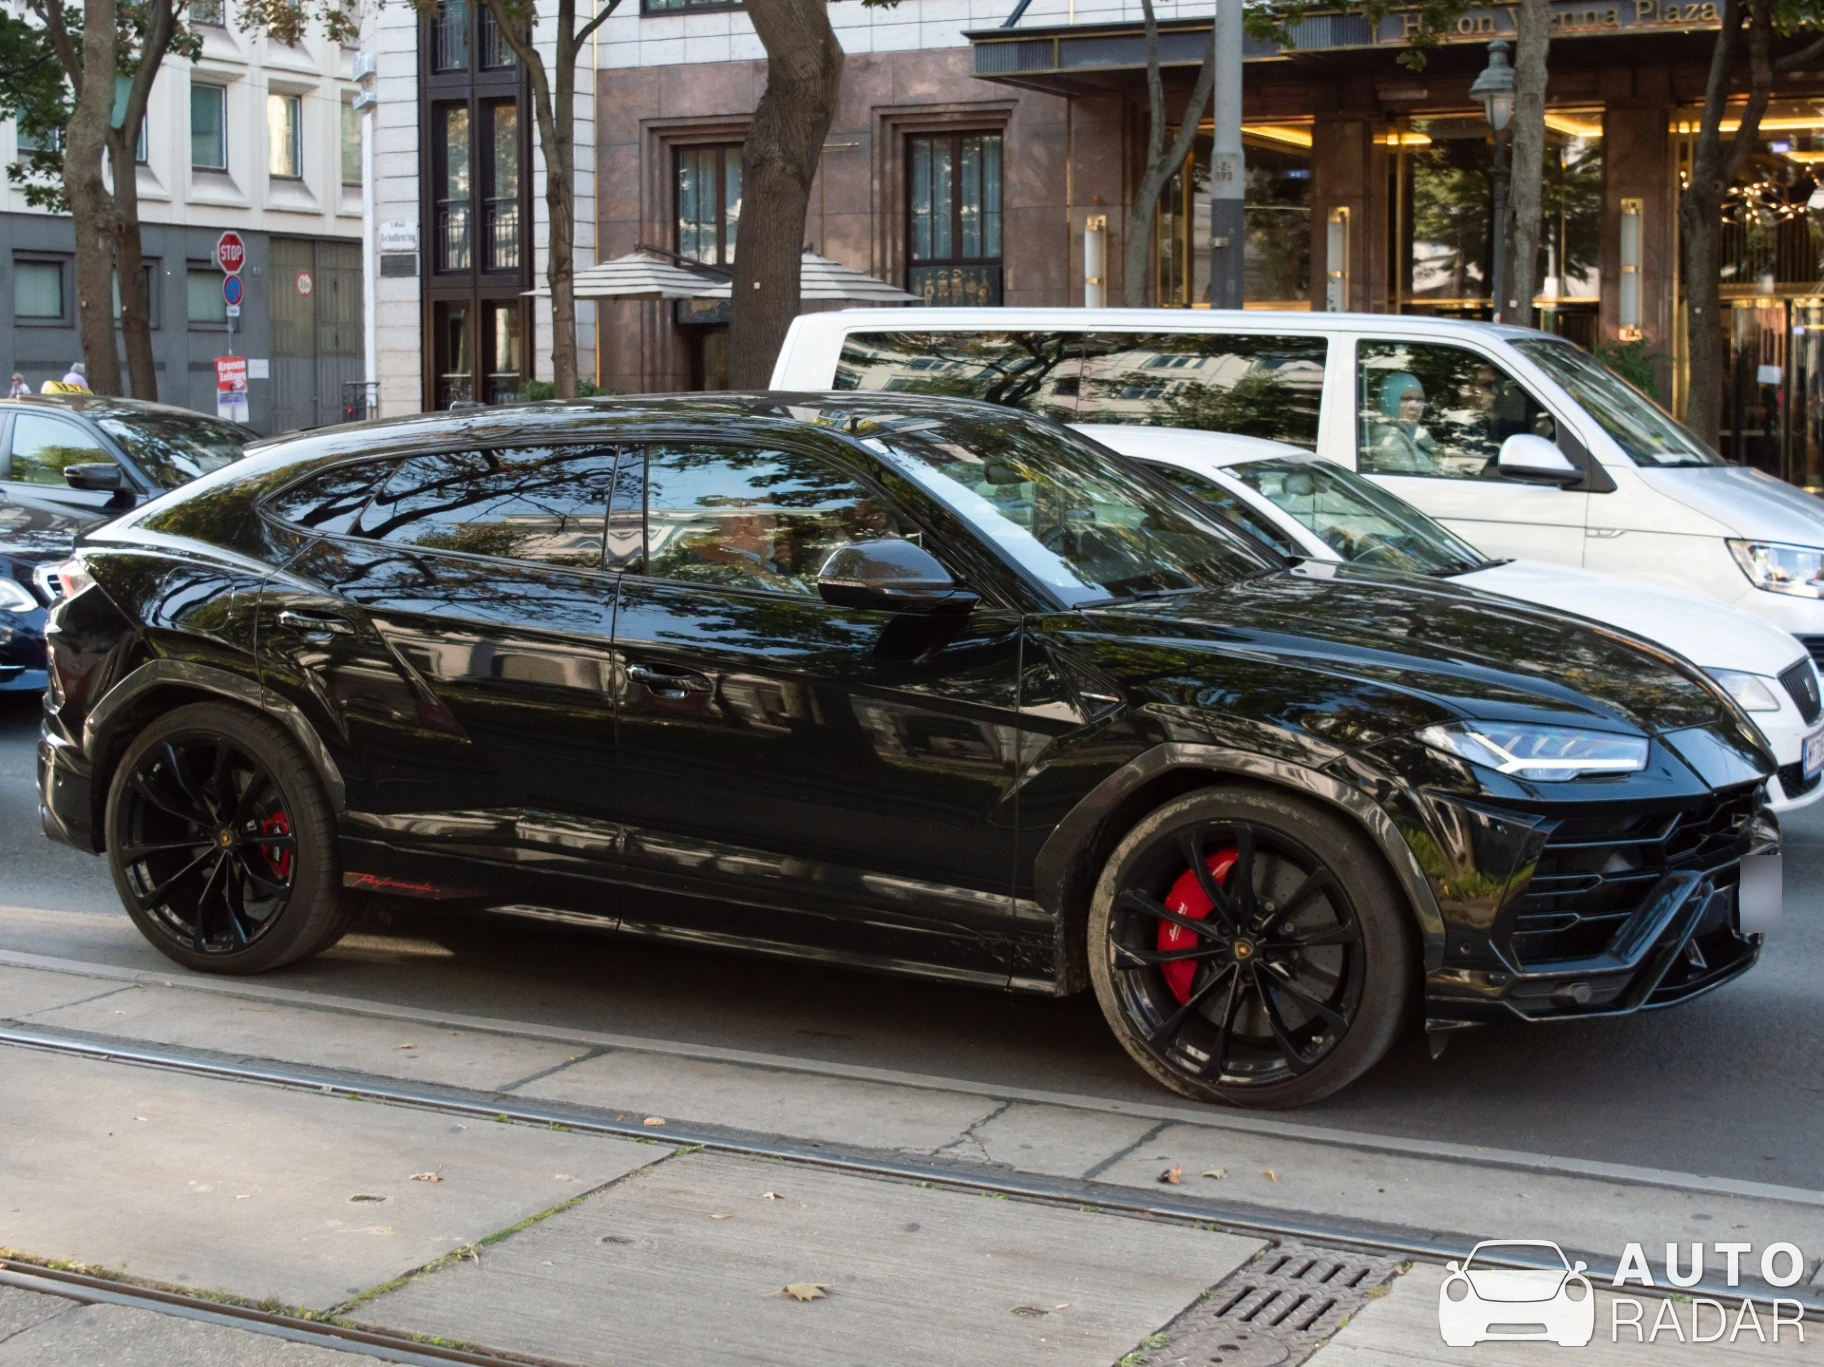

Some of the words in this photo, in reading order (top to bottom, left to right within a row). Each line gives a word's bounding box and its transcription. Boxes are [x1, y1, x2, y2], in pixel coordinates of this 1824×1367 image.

[1400, 13, 1496, 38] Hon
[1634, 0, 1720, 25] Plaza
[220, 245, 242, 261] STOP
[217, 360, 246, 371] Kronen
